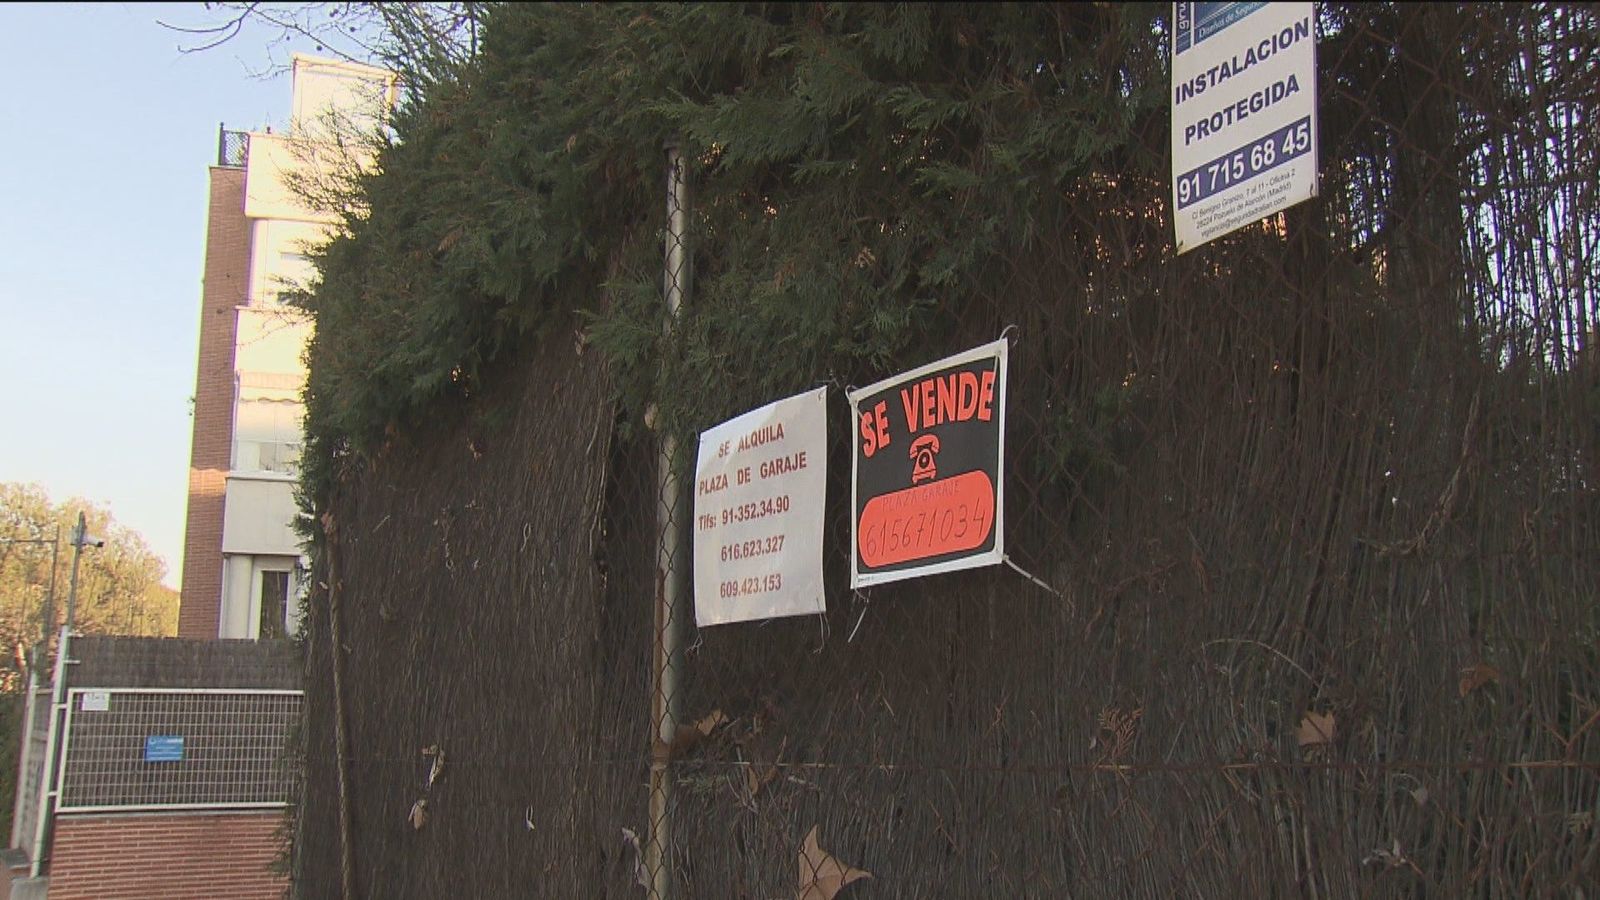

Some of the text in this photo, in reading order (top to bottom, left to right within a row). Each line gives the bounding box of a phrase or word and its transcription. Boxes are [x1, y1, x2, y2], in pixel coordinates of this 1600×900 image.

[1176, 17, 1309, 105] INSTALACION
[1185, 73, 1300, 146] PROTEGIDA
[1179, 121, 1308, 203] 91 715 68 45
[860, 370, 997, 458] SE VENDE
[718, 423, 785, 458] SE ALQUILA
[699, 451, 807, 496] PLAZA DE GARAJE
[882, 490, 917, 512] PLAZA
[721, 535, 785, 562] 616.623.327
[865, 498, 986, 557] 615671034
[720, 573, 782, 598] 609.423.153
